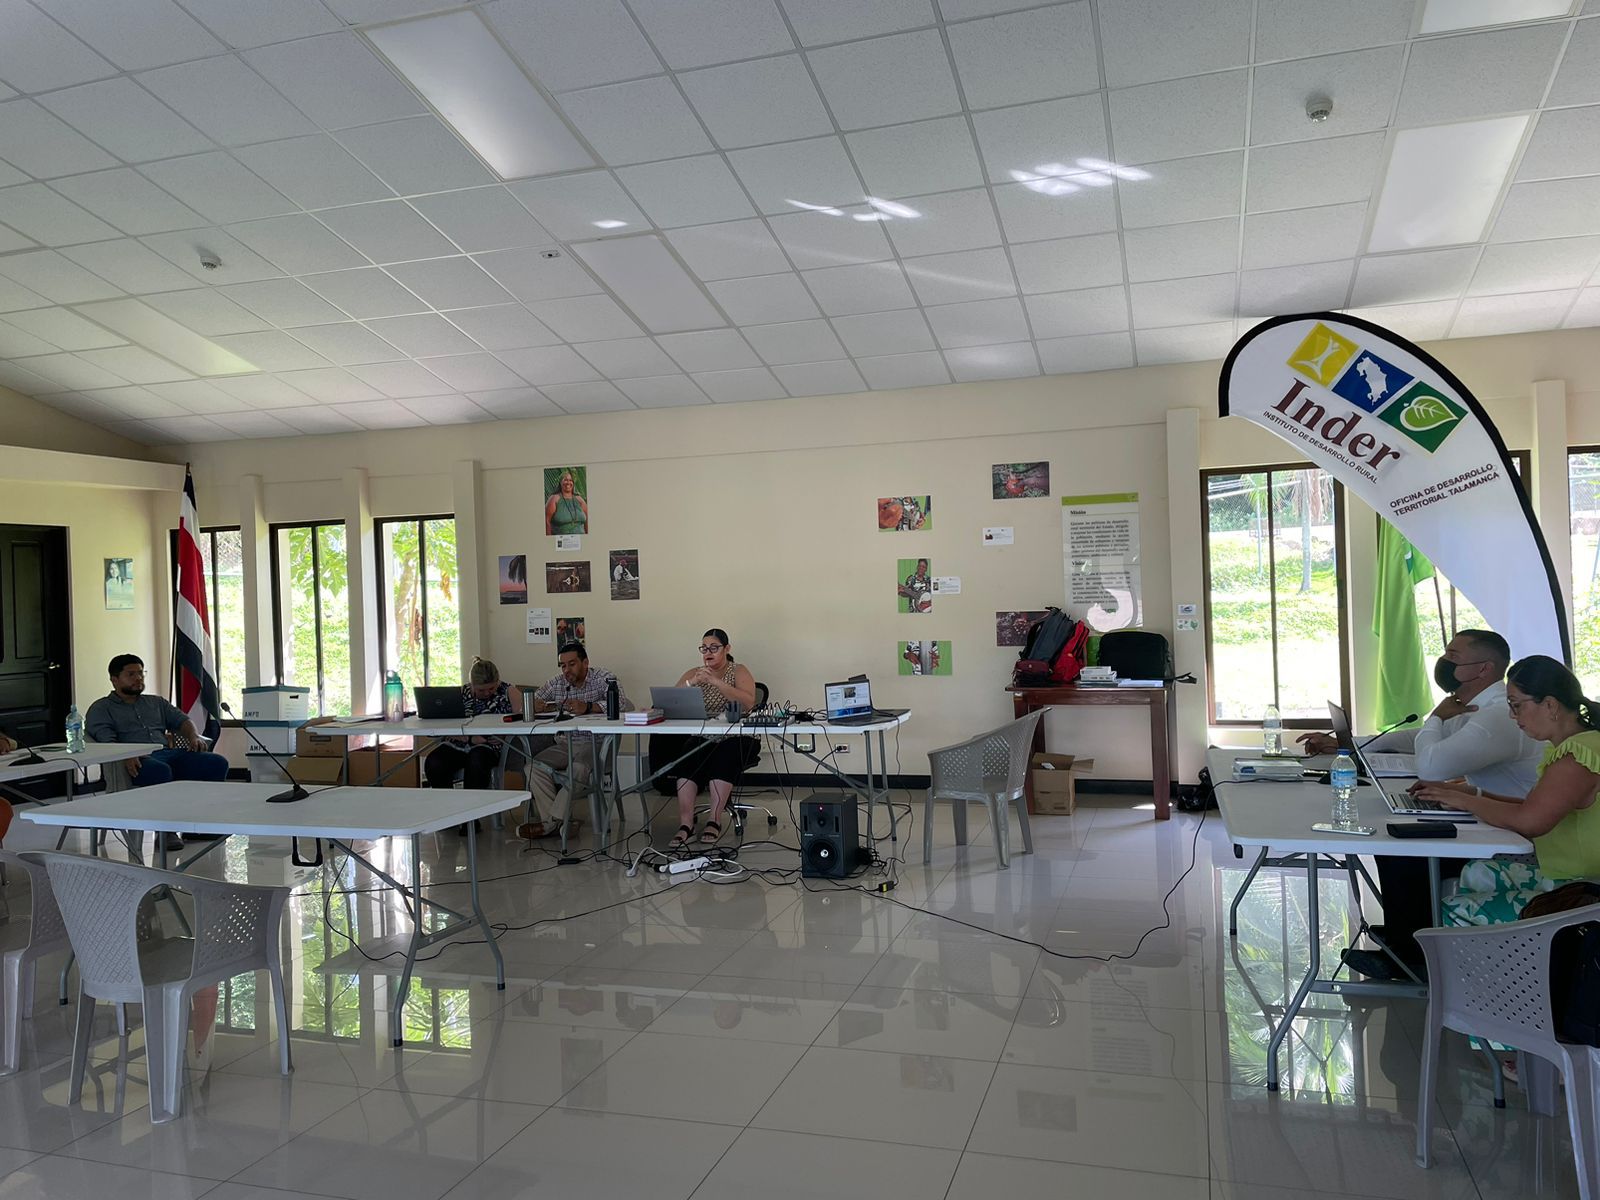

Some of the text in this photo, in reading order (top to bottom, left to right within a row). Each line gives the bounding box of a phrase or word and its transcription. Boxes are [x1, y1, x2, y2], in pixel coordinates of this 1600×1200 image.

[1263, 410, 1378, 484] INSTITUTO DE DESARROLLO RURAL
[1270, 377, 1401, 471] Inder
[1390, 463, 1493, 508] OFICINA DE DESARROLLO
[1394, 471, 1500, 517] TERRITORIAL TALAMANCA
